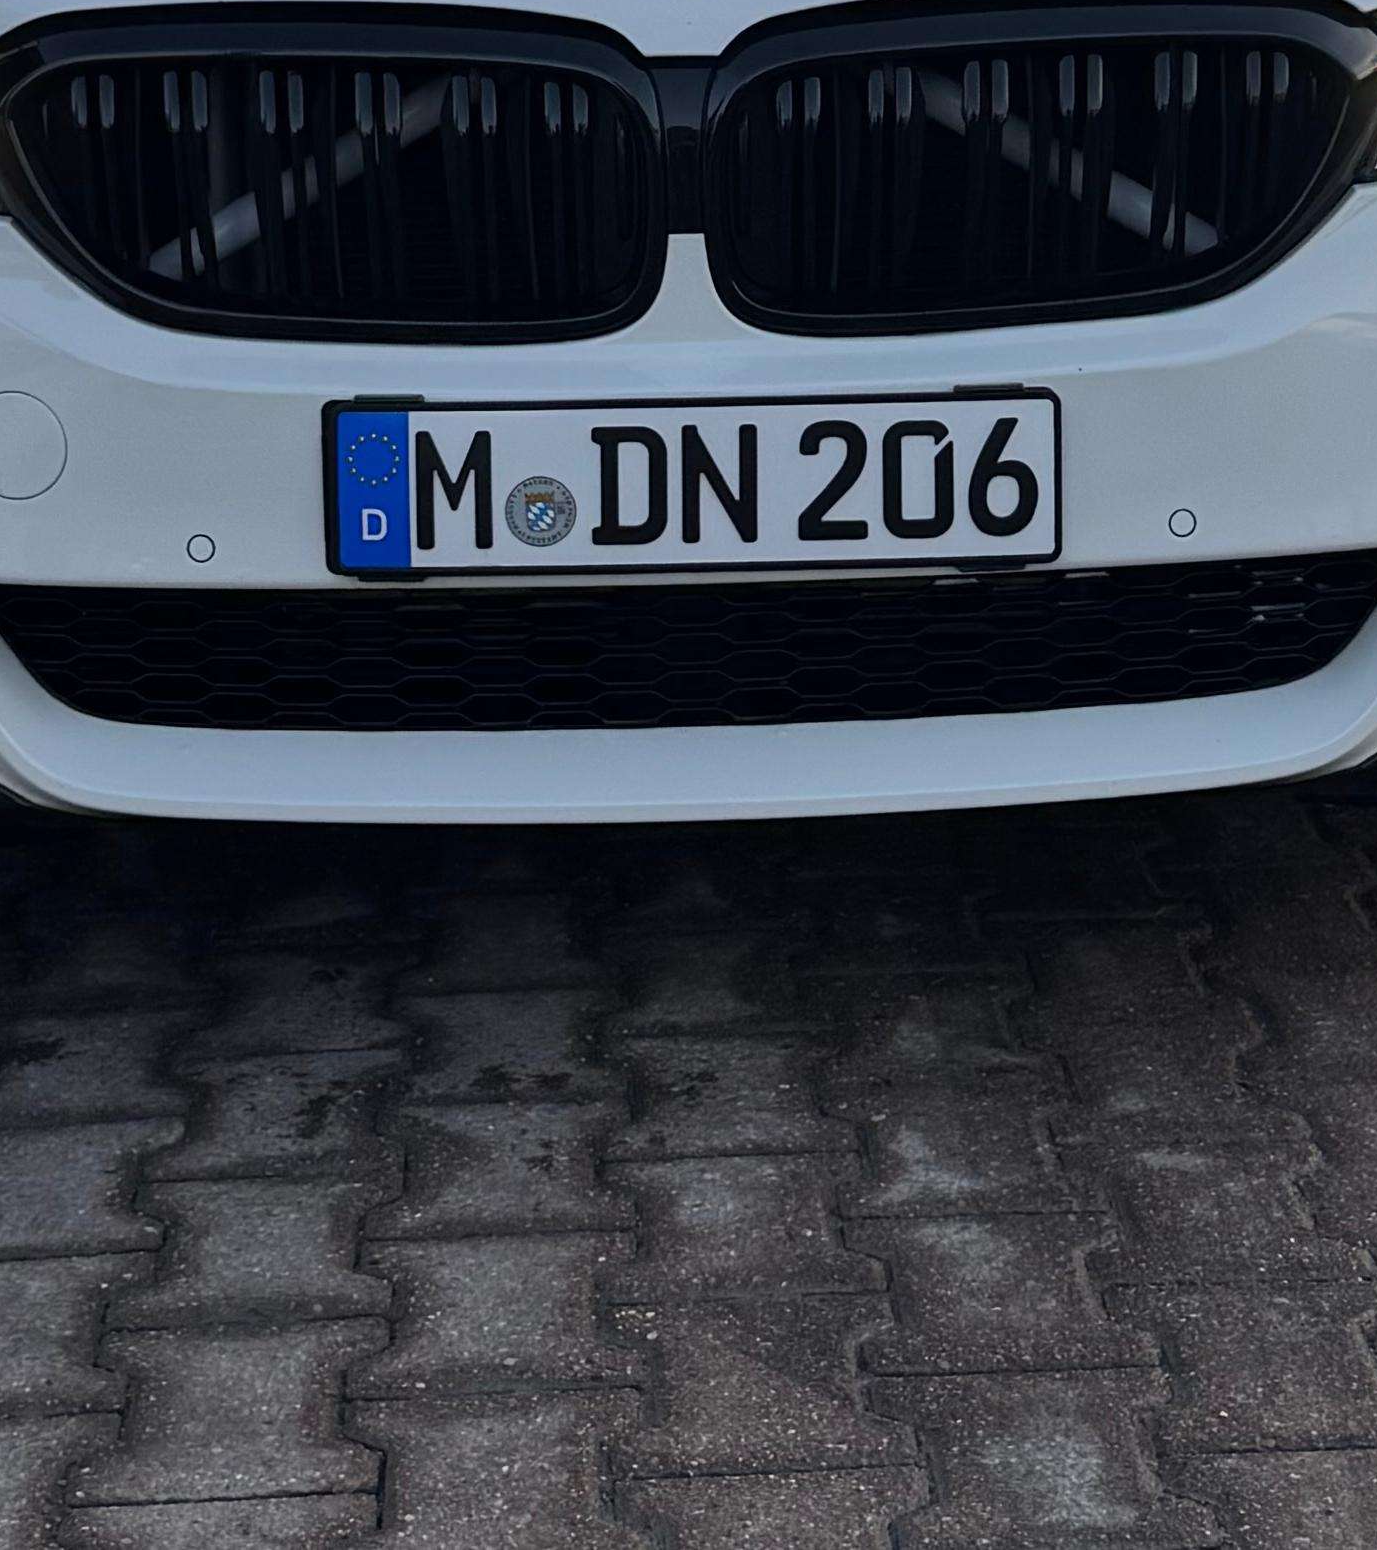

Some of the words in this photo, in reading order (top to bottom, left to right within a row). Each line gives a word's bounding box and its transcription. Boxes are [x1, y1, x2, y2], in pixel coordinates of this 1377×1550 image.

[361, 508, 388, 541] D
[415, 430, 494, 550] M
[590, 424, 759, 546] DN
[798, 417, 1039, 541] 206
